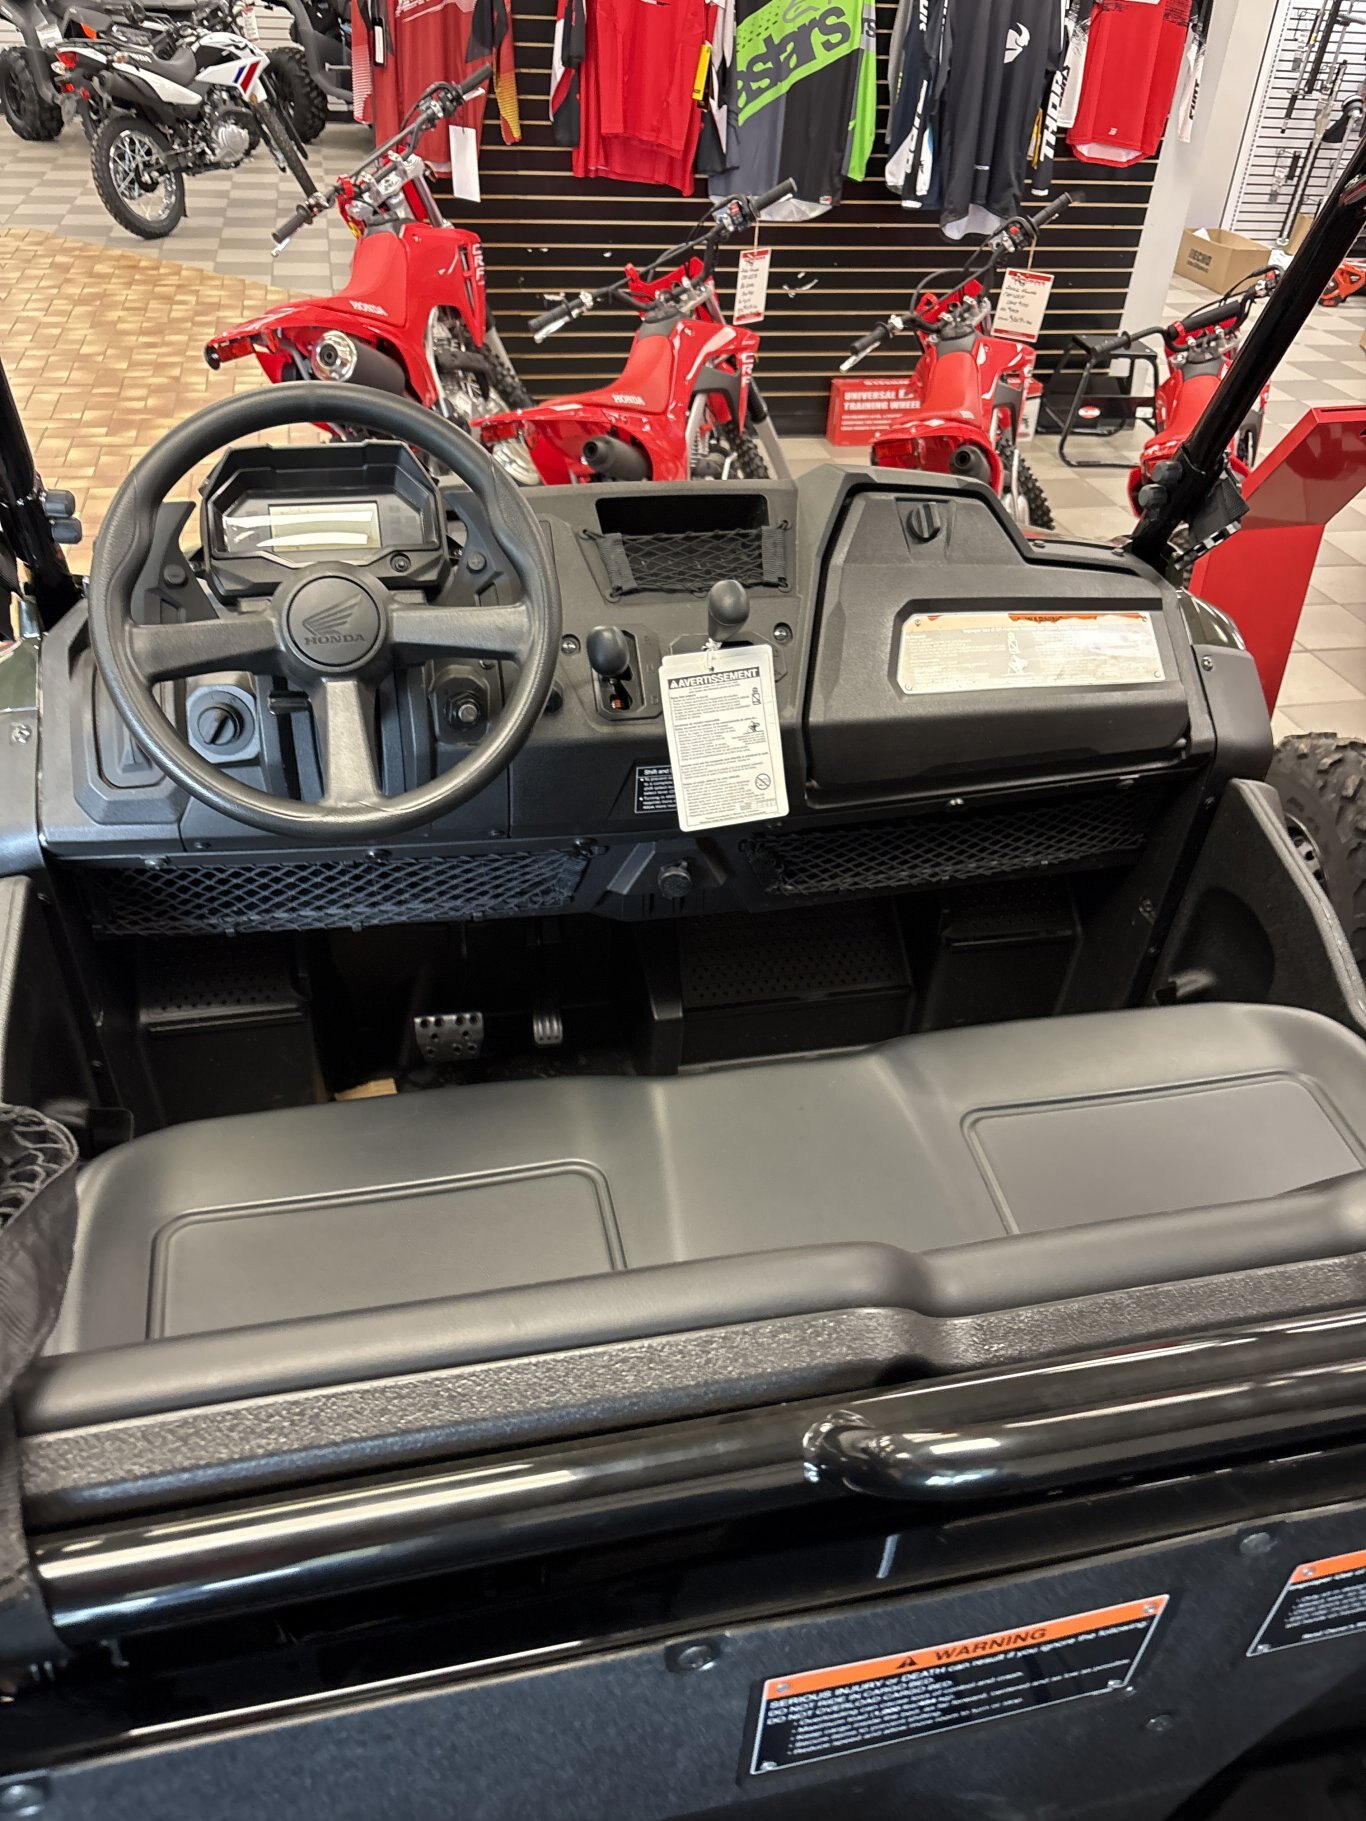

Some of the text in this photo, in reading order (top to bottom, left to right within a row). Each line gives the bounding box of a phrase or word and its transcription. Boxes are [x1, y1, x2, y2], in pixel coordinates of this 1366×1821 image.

[349, 300, 388, 316] HONDA
[612, 394, 646, 406] HONDA
[844, 391, 896, 401] UNIVERSAL
[844, 400, 921, 411] TRAINING WHEEL
[303, 634, 366, 646] HONDA
[677, 669, 758, 688] AVERTISSEMENT
[936, 1628, 1047, 1661] WARNING
[769, 1690, 832, 1709] SERIOUS
[834, 1680, 883, 1695] INJURY
[900, 1667, 946, 1681] DEATH
[947, 1662, 971, 1672] can
[766, 1715, 786, 1725] DO
[787, 1709, 813, 1720] NOT
[815, 1695, 882, 1715] OVERLOAD
[882, 1686, 927, 1700] CARGO
[768, 1708, 788, 1718] DO
[789, 1702, 815, 1712] NOT
[816, 1696, 846, 1707] RIDE
[862, 1683, 908, 1697] CARGO
[797, 1719, 845, 1732] Maximum
[799, 1709, 859, 1726] Overloading
